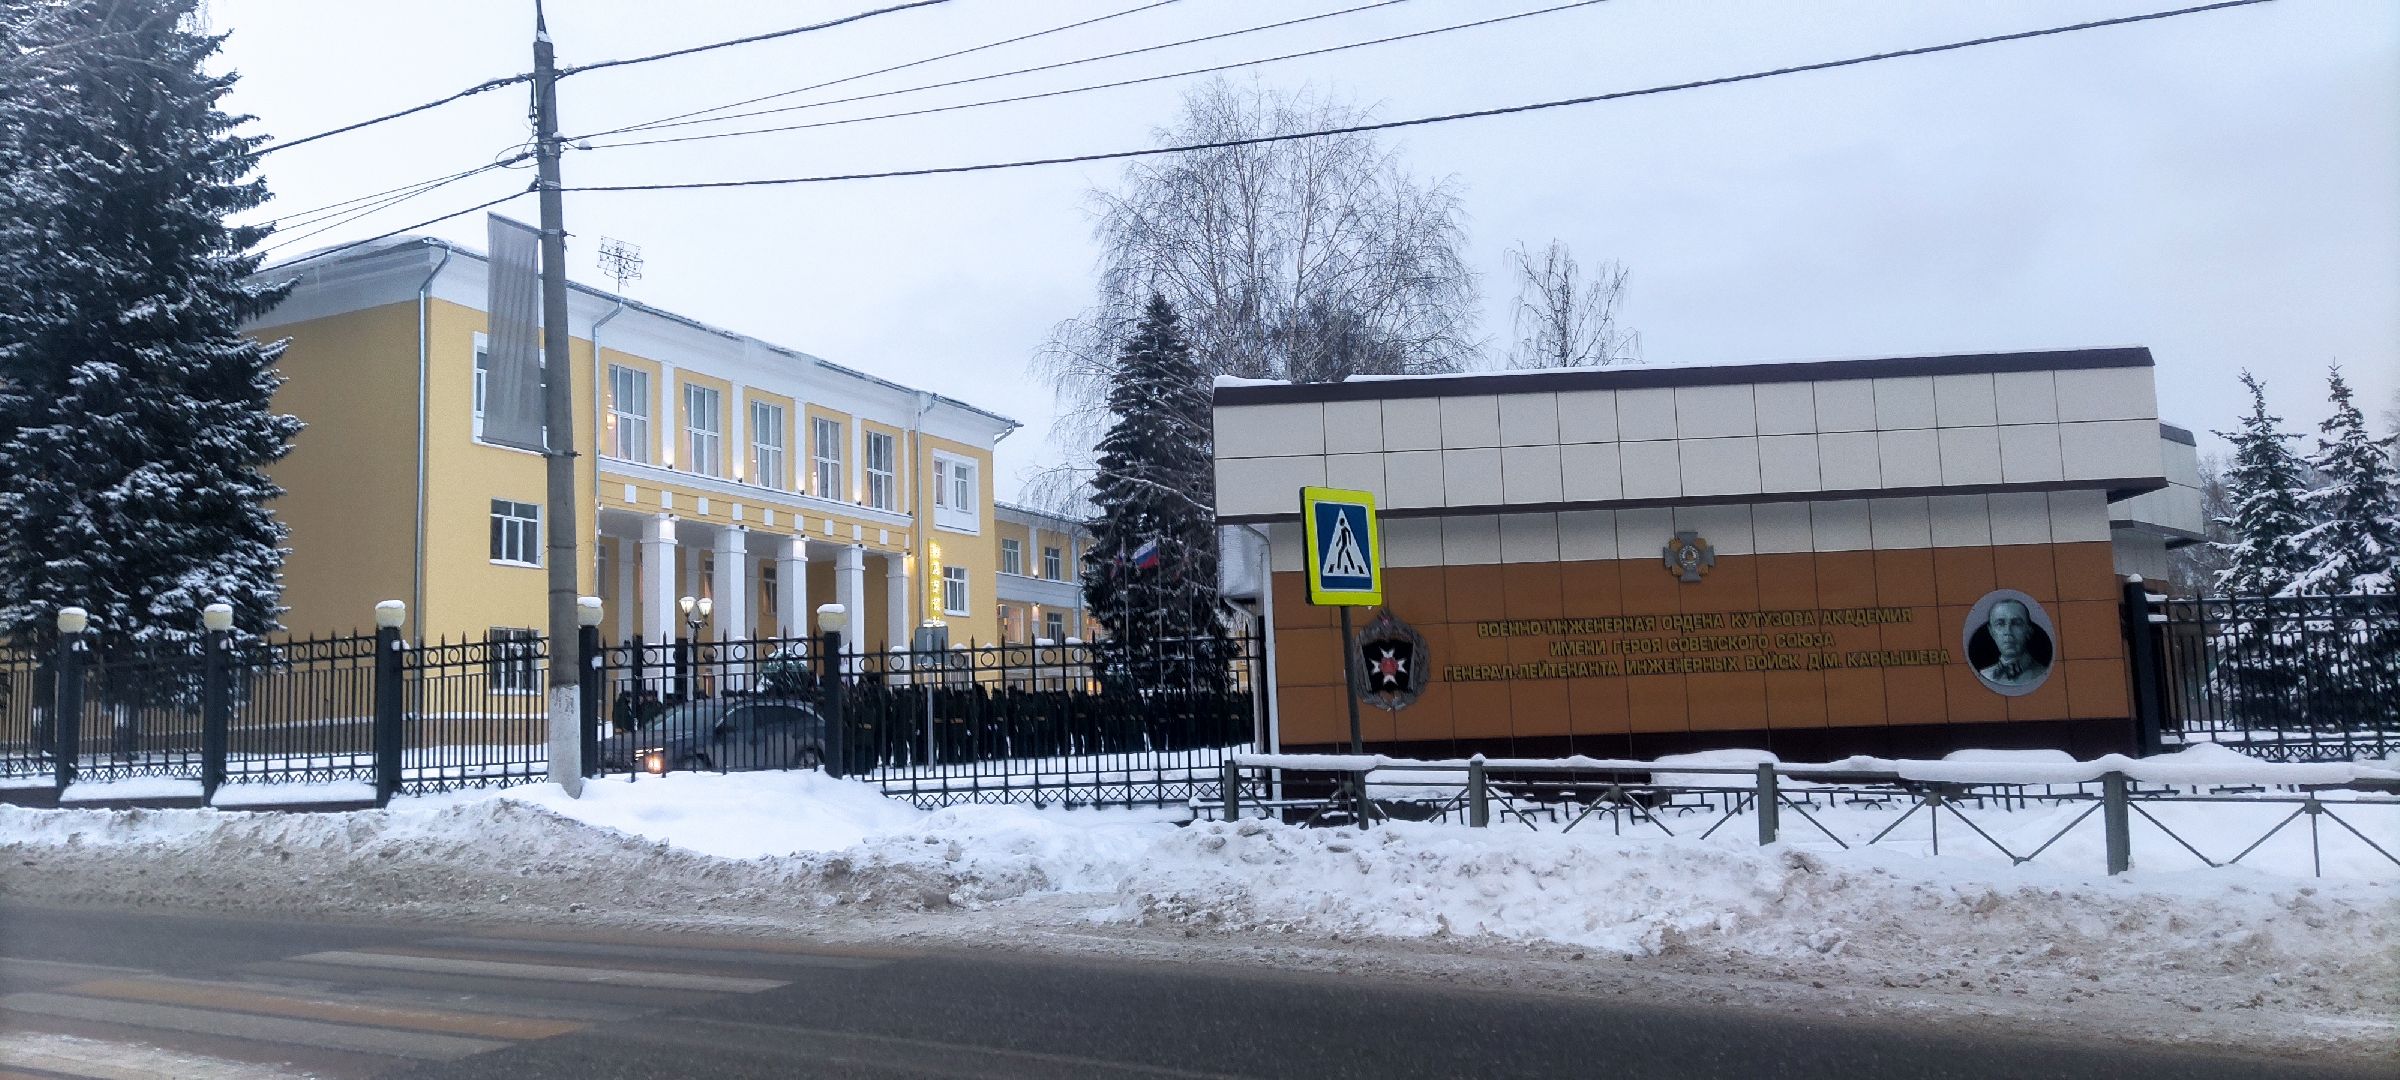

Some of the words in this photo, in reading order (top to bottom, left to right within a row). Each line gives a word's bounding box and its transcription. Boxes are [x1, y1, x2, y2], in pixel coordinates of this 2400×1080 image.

[1662, 613, 1723, 633] ОРДЕНА
[1730, 609, 1814, 628] КУТУЗОВА
[1822, 607, 1912, 626] АКАДЕМИЯ
[1549, 639, 1605, 655] ИМЕНИ
[1612, 637, 1661, 653] ГЕРОЯ
[1667, 634, 1768, 651] СОВЕТСКОГО
[1775, 632, 1835, 647] СОЮЗА
[1625, 655, 1739, 673] ИНЖЕНЕРНЫХ
[1745, 651, 1800, 669] ВОЙСК
[1846, 648, 1951, 666] КАРБЫШЕВА
